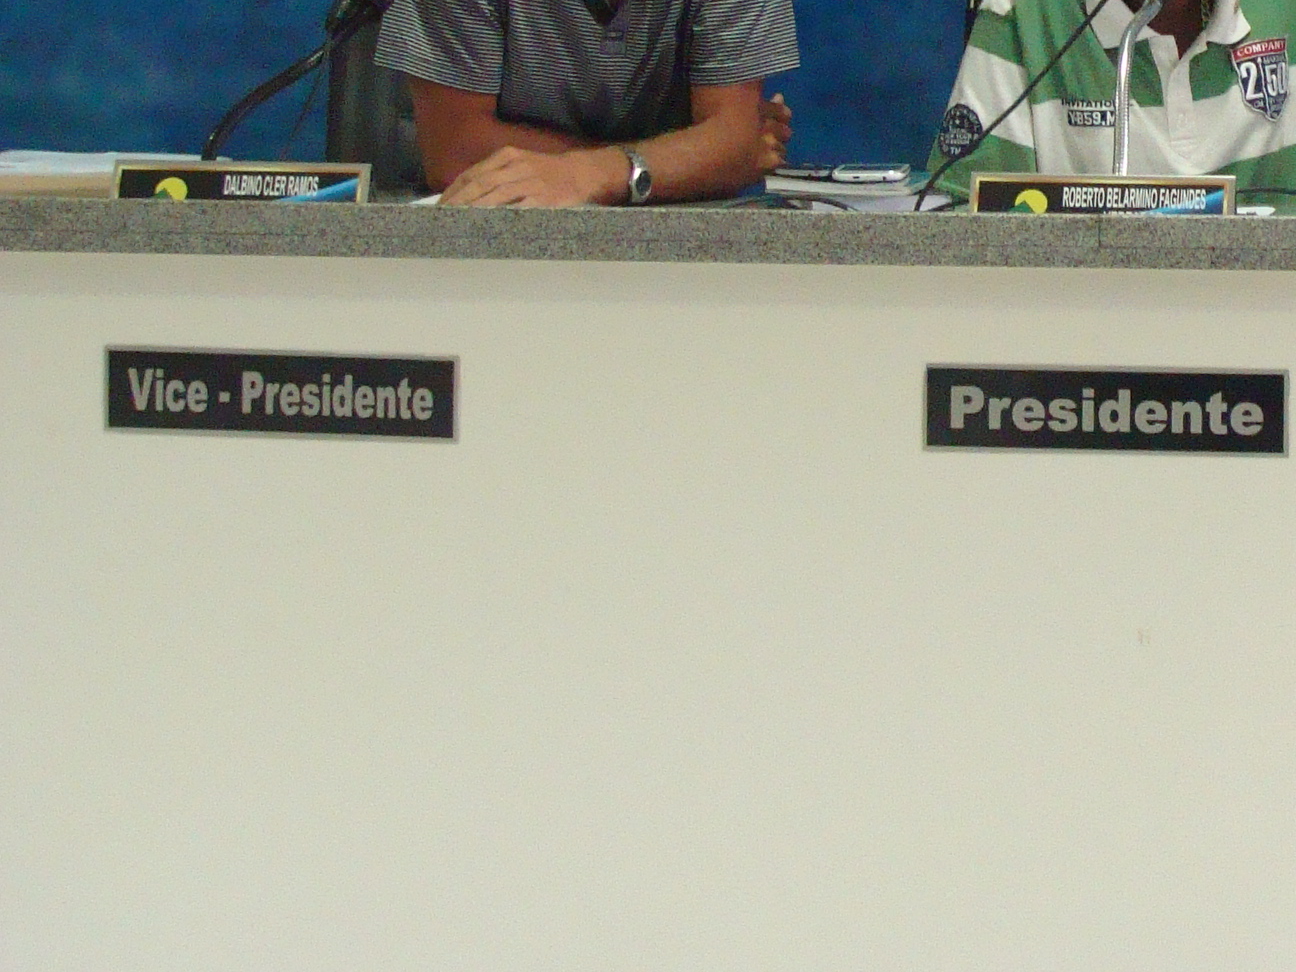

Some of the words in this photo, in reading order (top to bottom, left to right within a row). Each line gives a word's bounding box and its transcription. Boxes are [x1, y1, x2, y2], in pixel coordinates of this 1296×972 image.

[223, 174, 262, 195] DALBINO
[263, 175, 287, 196] CLER
[287, 175, 319, 197] RAMOS
[1062, 186, 1105, 208] ROBERTO
[1106, 187, 1158, 209] BELARMINO
[1159, 188, 1207, 210] FAGUNDES
[127, 367, 208, 413] Vice
[240, 370, 434, 421] Presidente
[949, 384, 1265, 436] Presidente
